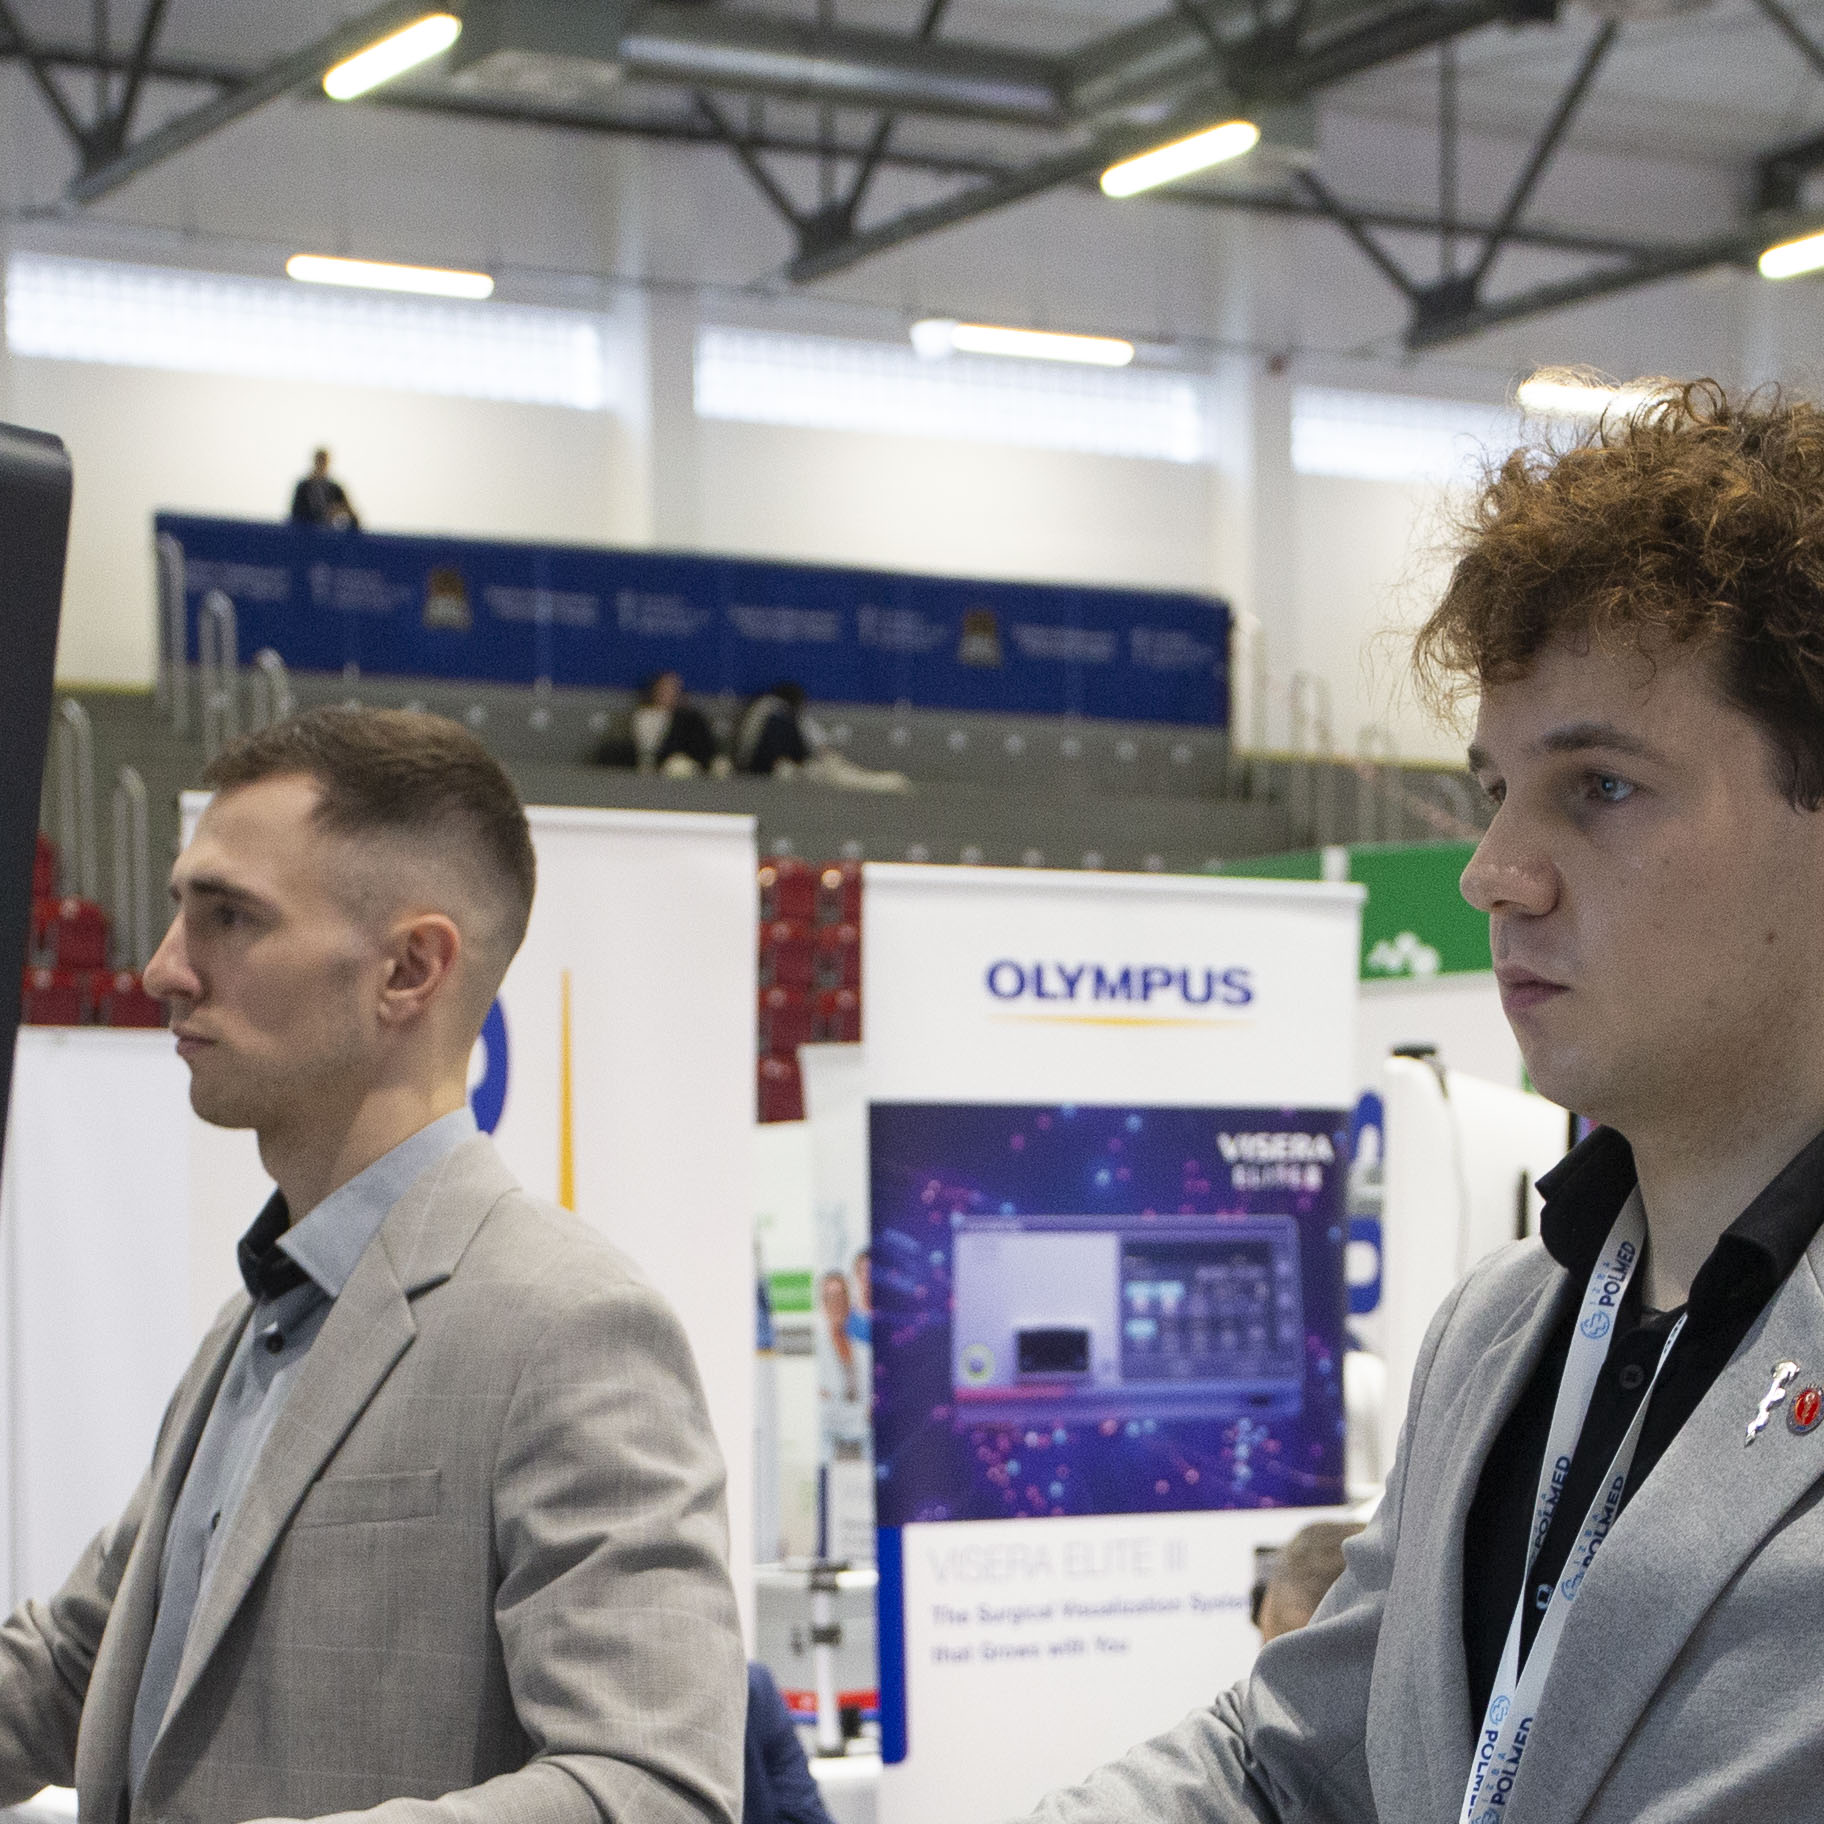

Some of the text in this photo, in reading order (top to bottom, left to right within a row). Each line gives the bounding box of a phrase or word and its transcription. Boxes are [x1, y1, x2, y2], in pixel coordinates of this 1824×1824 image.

[984, 959, 1255, 1008] OLYMPUS
[1216, 1132, 1336, 1165] VISERA
[1599, 1240, 1636, 1308] POLMED
[1534, 1455, 1571, 1549] POLMED
[1490, 1716, 1534, 1806] POLMED
